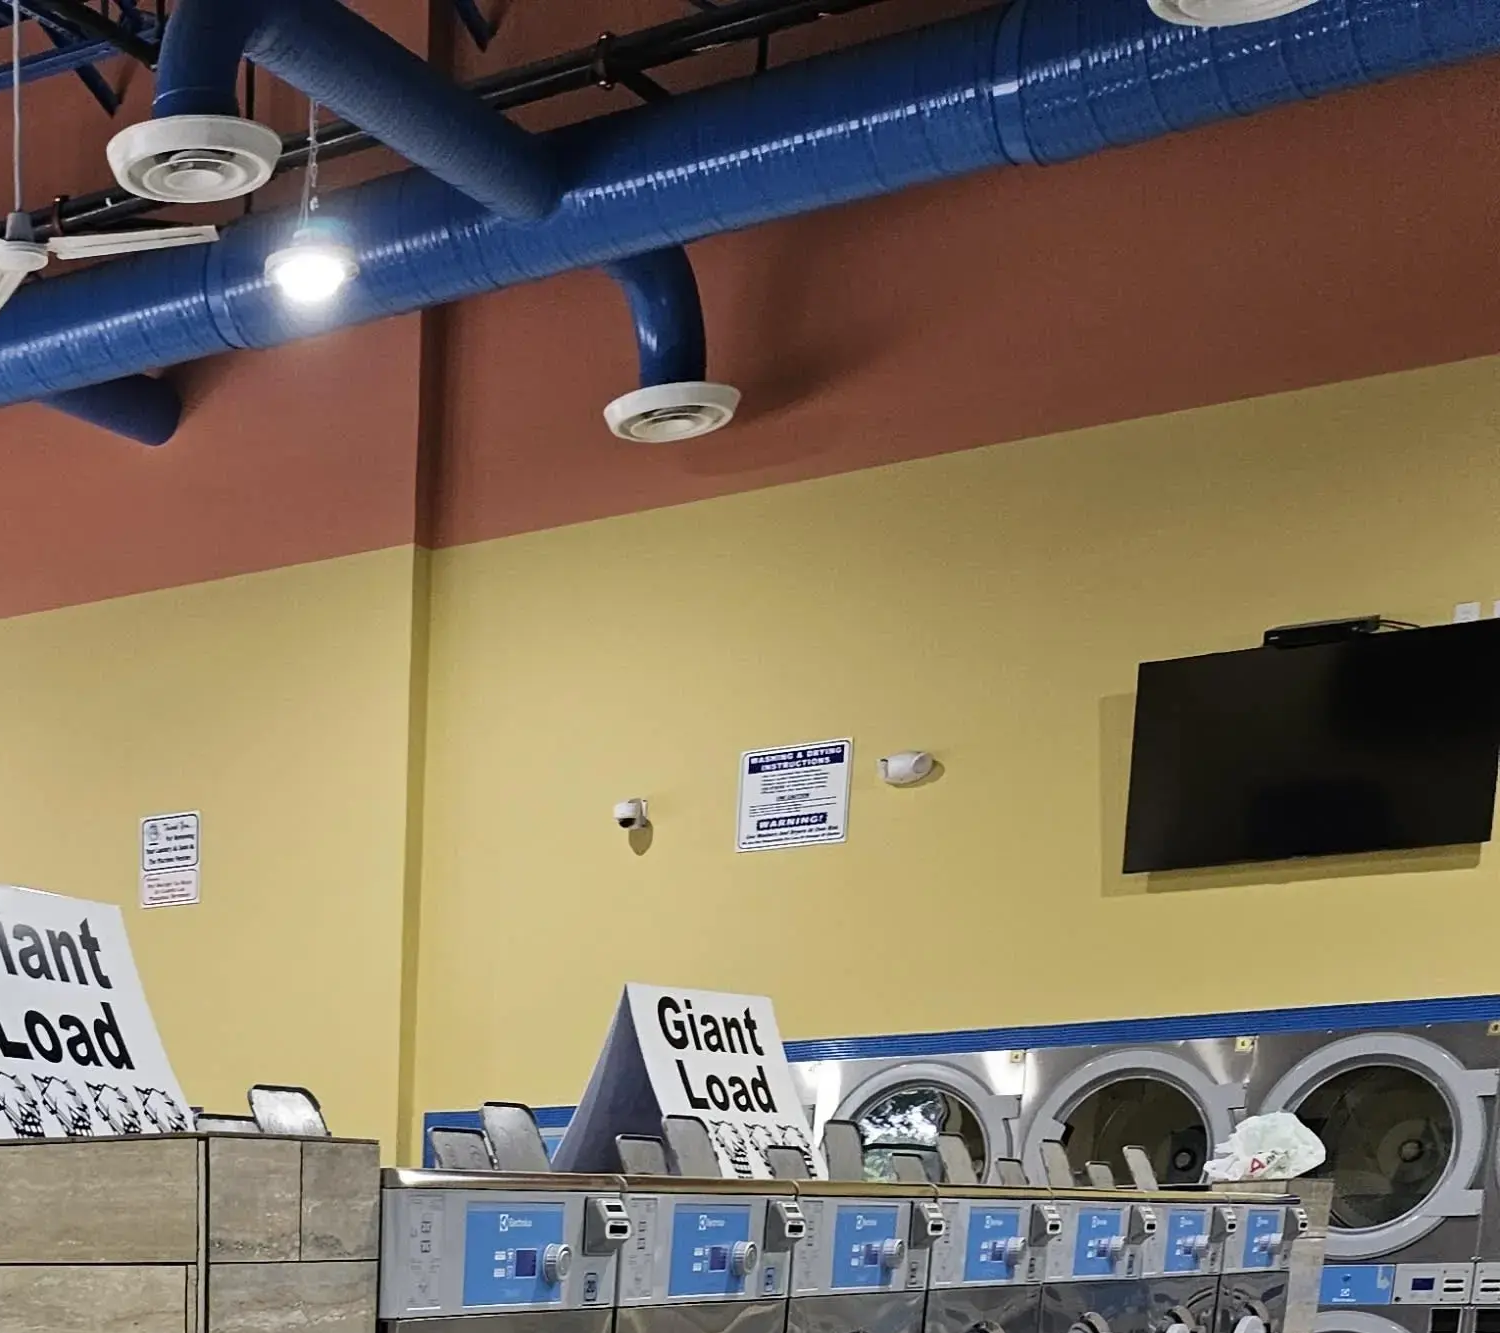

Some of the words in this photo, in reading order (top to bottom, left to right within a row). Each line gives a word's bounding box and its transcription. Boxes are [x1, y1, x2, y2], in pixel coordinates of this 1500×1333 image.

[760, 757, 832, 772] INSTRUCTIONS
[758, 815, 824, 830] WARNING!
[657, 995, 765, 1057] Giant
[675, 1058, 779, 1114] Load
